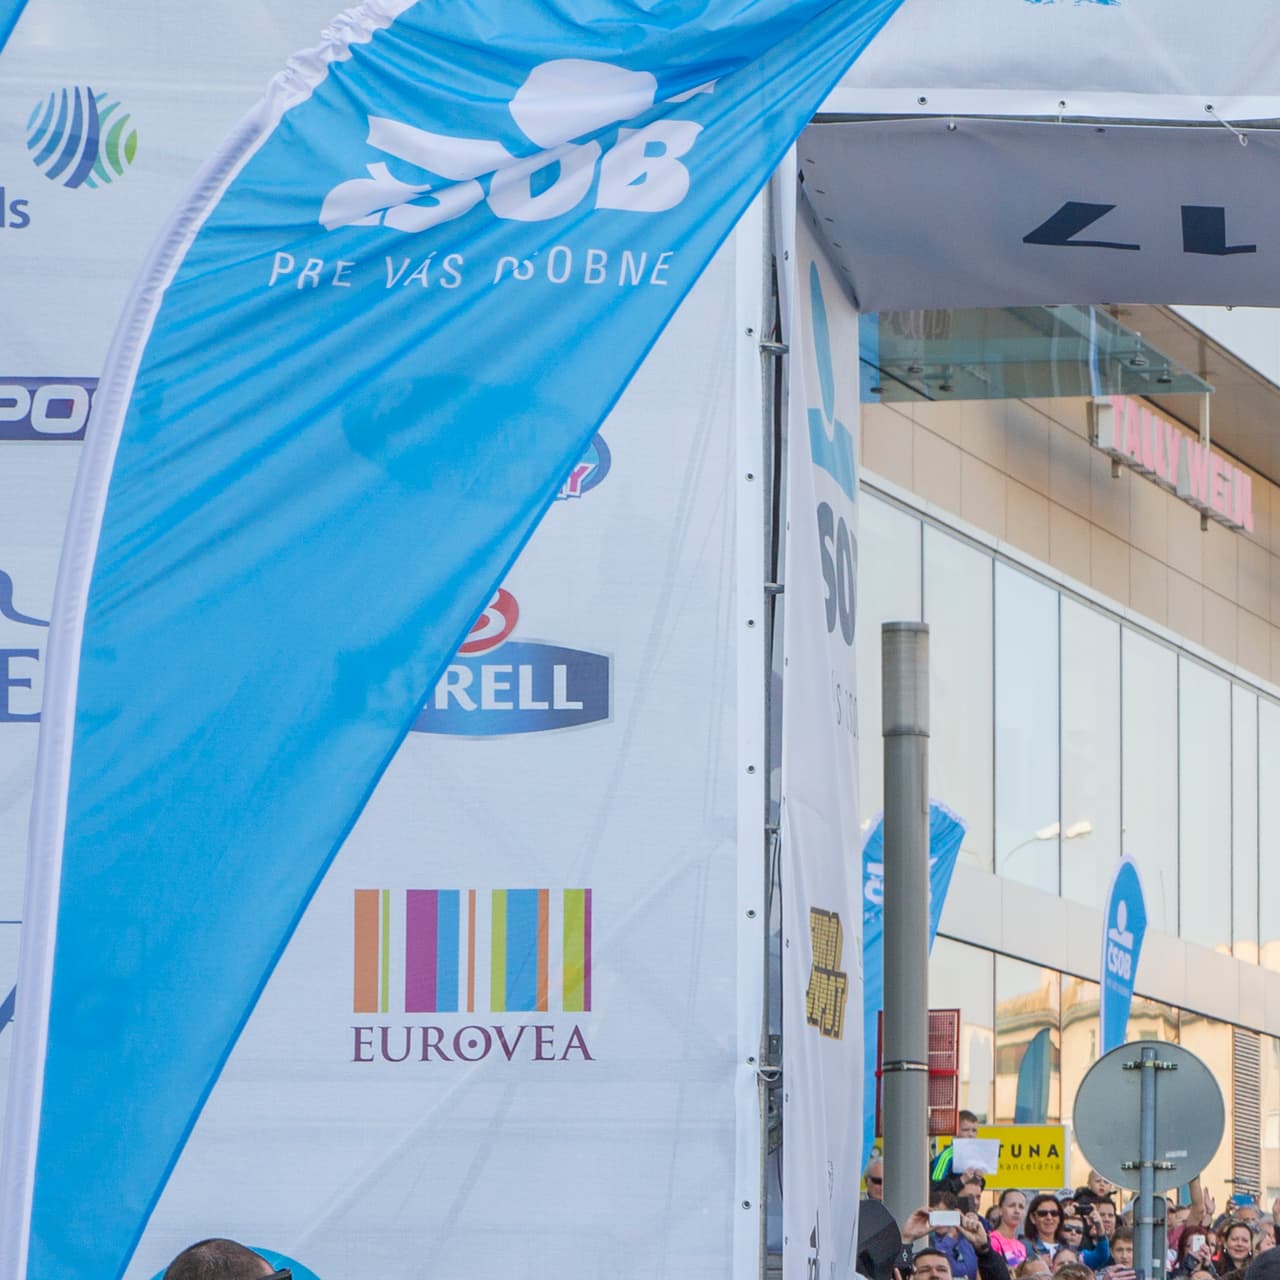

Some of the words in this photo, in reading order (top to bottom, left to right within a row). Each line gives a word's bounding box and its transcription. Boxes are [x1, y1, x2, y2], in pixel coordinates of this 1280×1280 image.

[269, 250, 353, 288] PRE
[385, 252, 463, 289] VÁS
[1107, 940, 1132, 981] ČSOB
[350, 1024, 597, 1064] EUROVEA
